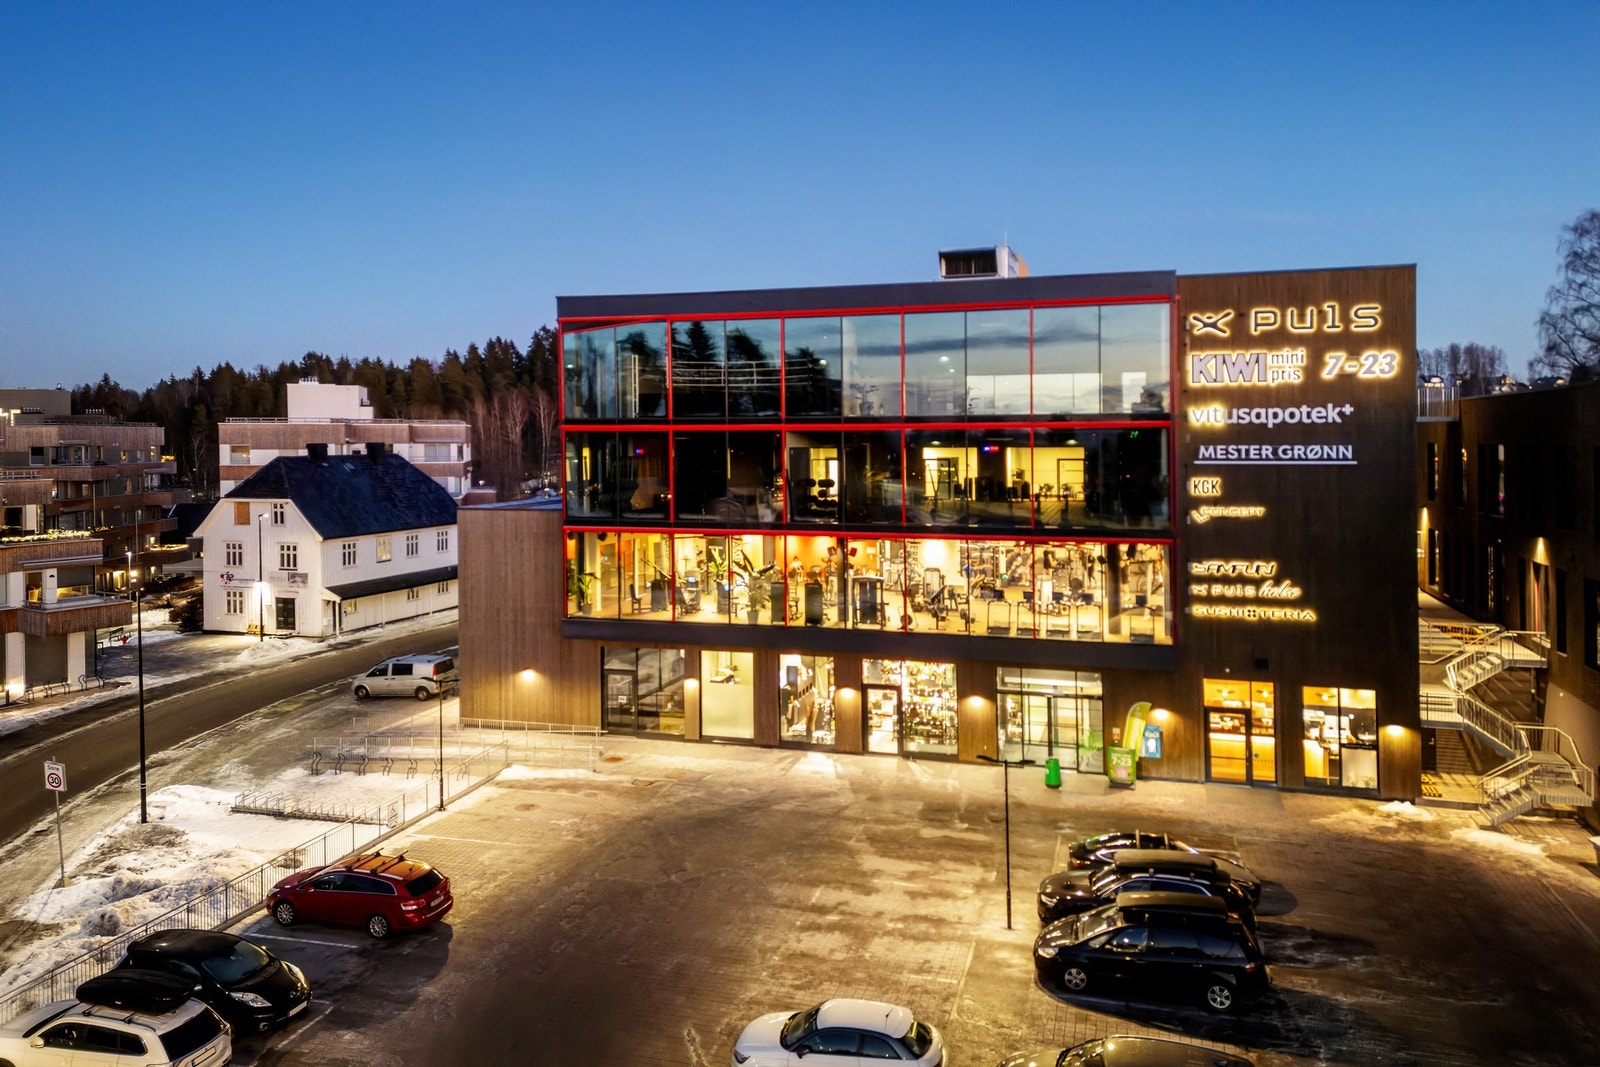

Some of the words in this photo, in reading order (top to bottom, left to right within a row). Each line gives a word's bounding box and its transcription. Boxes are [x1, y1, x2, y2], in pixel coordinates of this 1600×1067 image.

[1190, 352, 1268, 384] KIWI
[1271, 350, 1305, 365] mini
[1324, 352, 1397, 377] 7-23
[1271, 367, 1302, 384] pris
[1198, 444, 1273, 460] MESTER
[1277, 444, 1353, 460] GRØNN
[1192, 479, 1220, 495] KGK
[50, 776, 59, 785] 30
